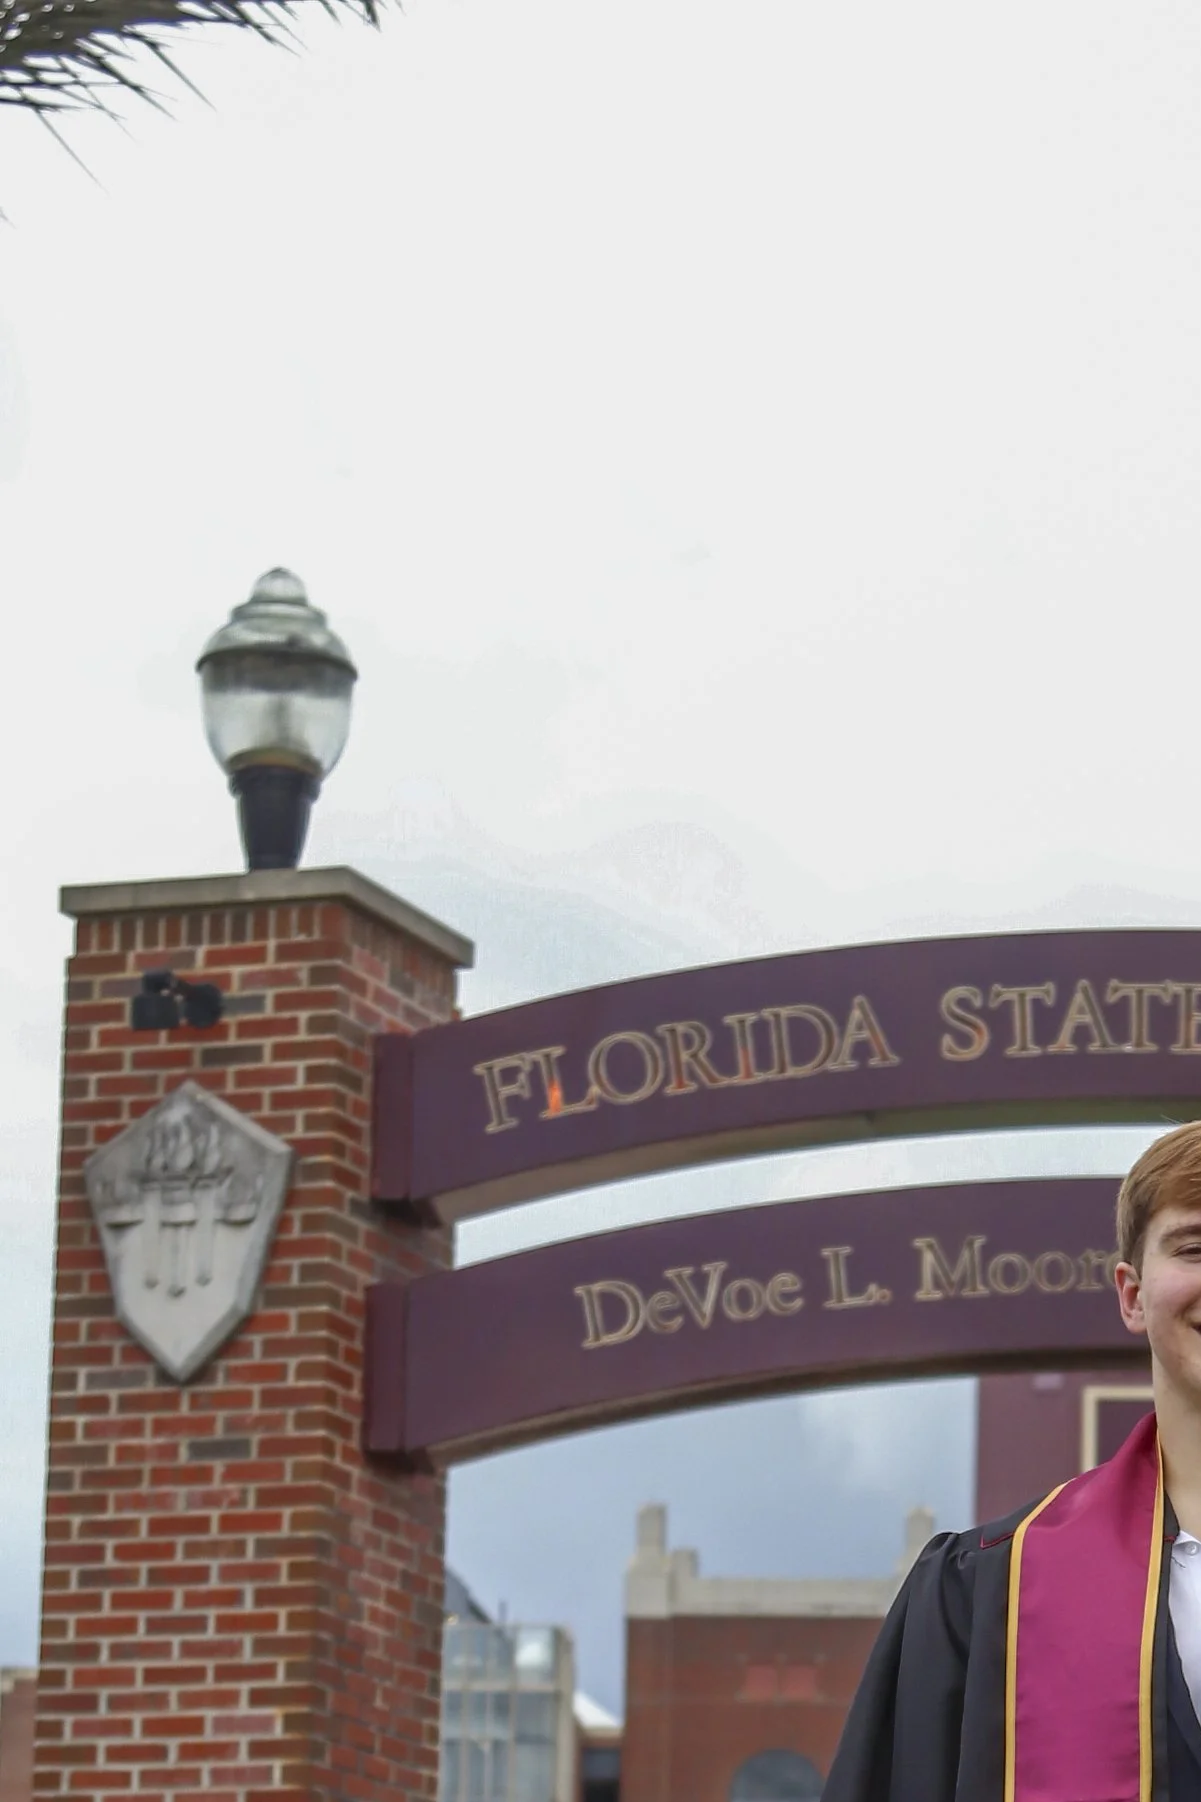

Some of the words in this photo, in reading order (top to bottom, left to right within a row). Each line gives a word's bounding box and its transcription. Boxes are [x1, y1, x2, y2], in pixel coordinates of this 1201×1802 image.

[474, 995, 901, 1135] FLORIDA
[574, 1260, 804, 1349] DeVoe
[821, 1247, 891, 1311] L.
